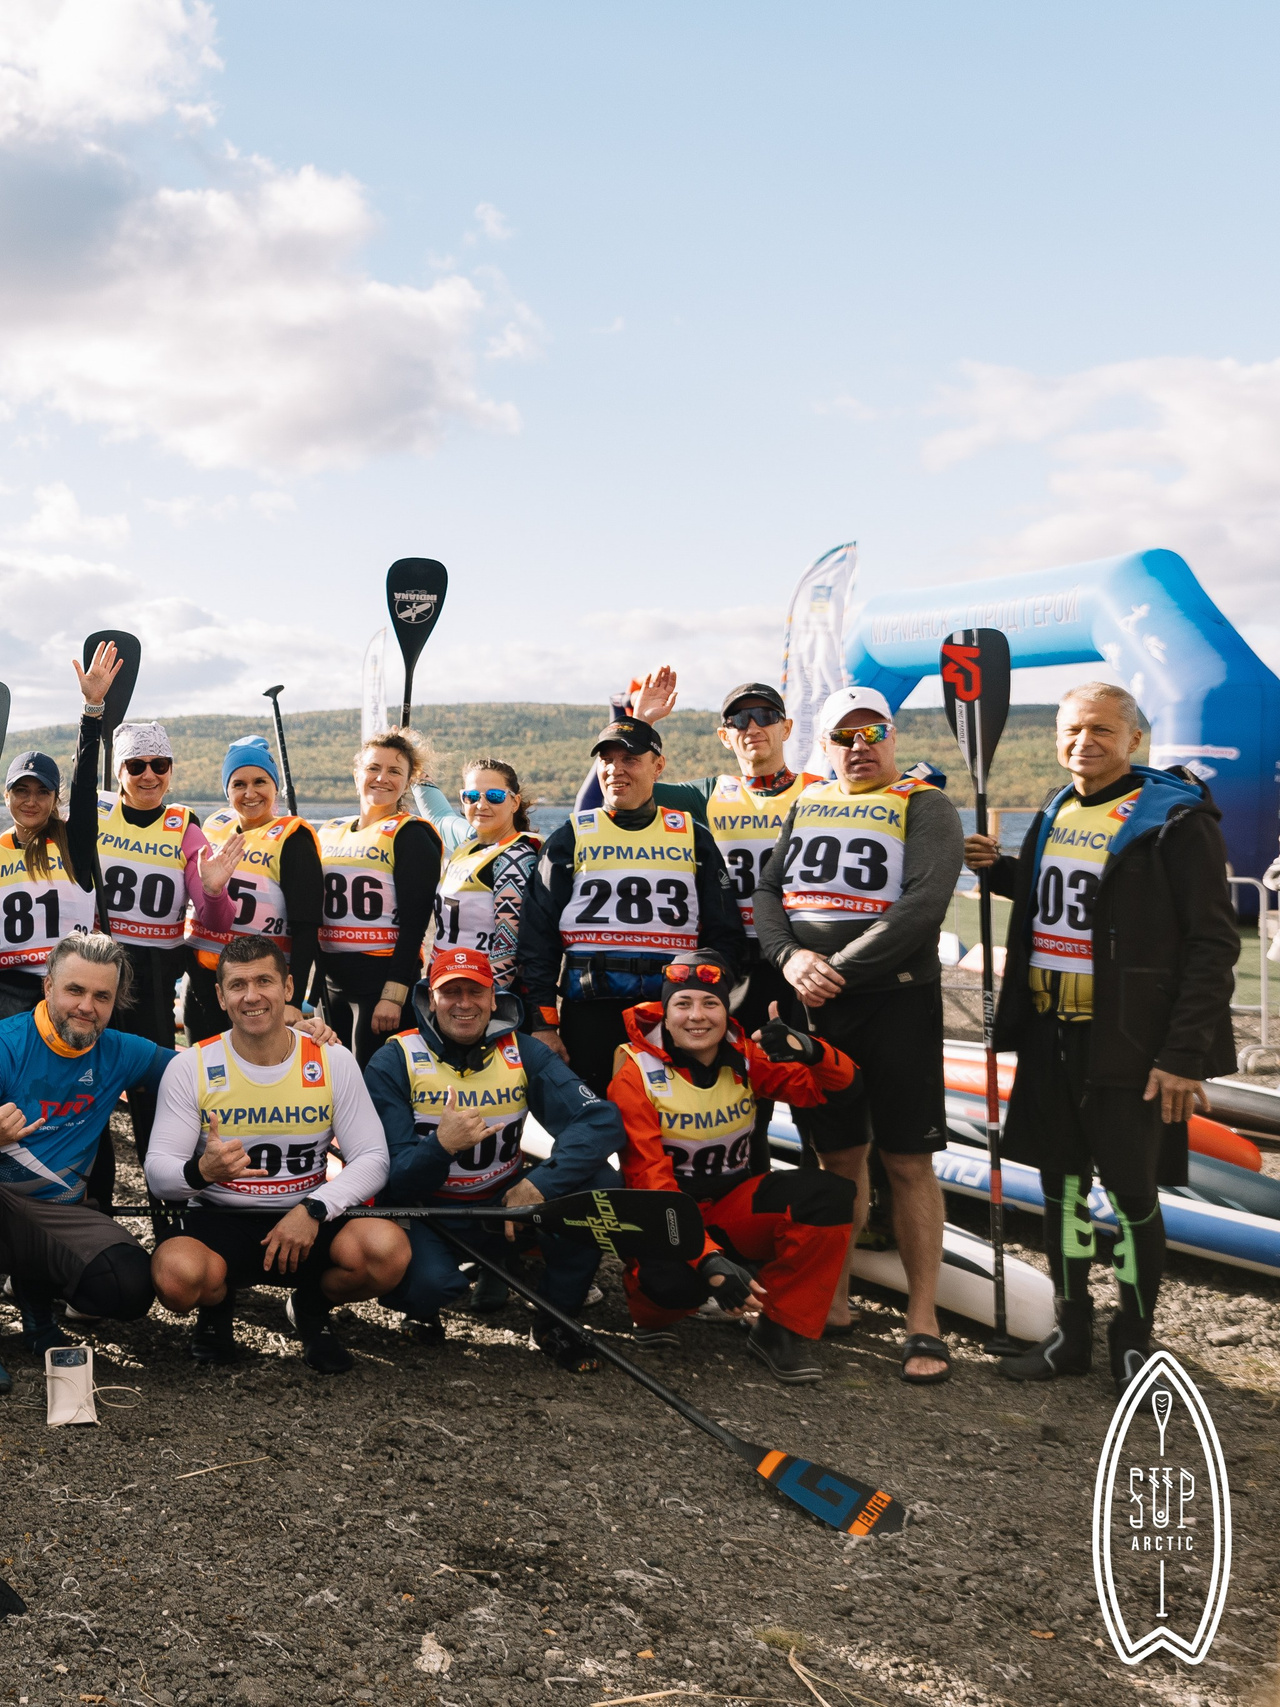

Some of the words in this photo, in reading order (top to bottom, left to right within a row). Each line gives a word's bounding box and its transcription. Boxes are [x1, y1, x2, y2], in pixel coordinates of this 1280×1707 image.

[394, 592, 438, 601] INDIANA
[870, 608, 948, 644] МУРМАНСК
[965, 599, 1020, 633] ГОРОД
[1023, 584, 1081, 627] ГЕРОЙ
[958, 719, 967, 745] PADDLE
[713, 815, 783, 830] МУРМА
[97, 832, 182, 860] УРМАНСК
[782, 836, 889, 892] 293
[575, 876, 690, 927] 283
